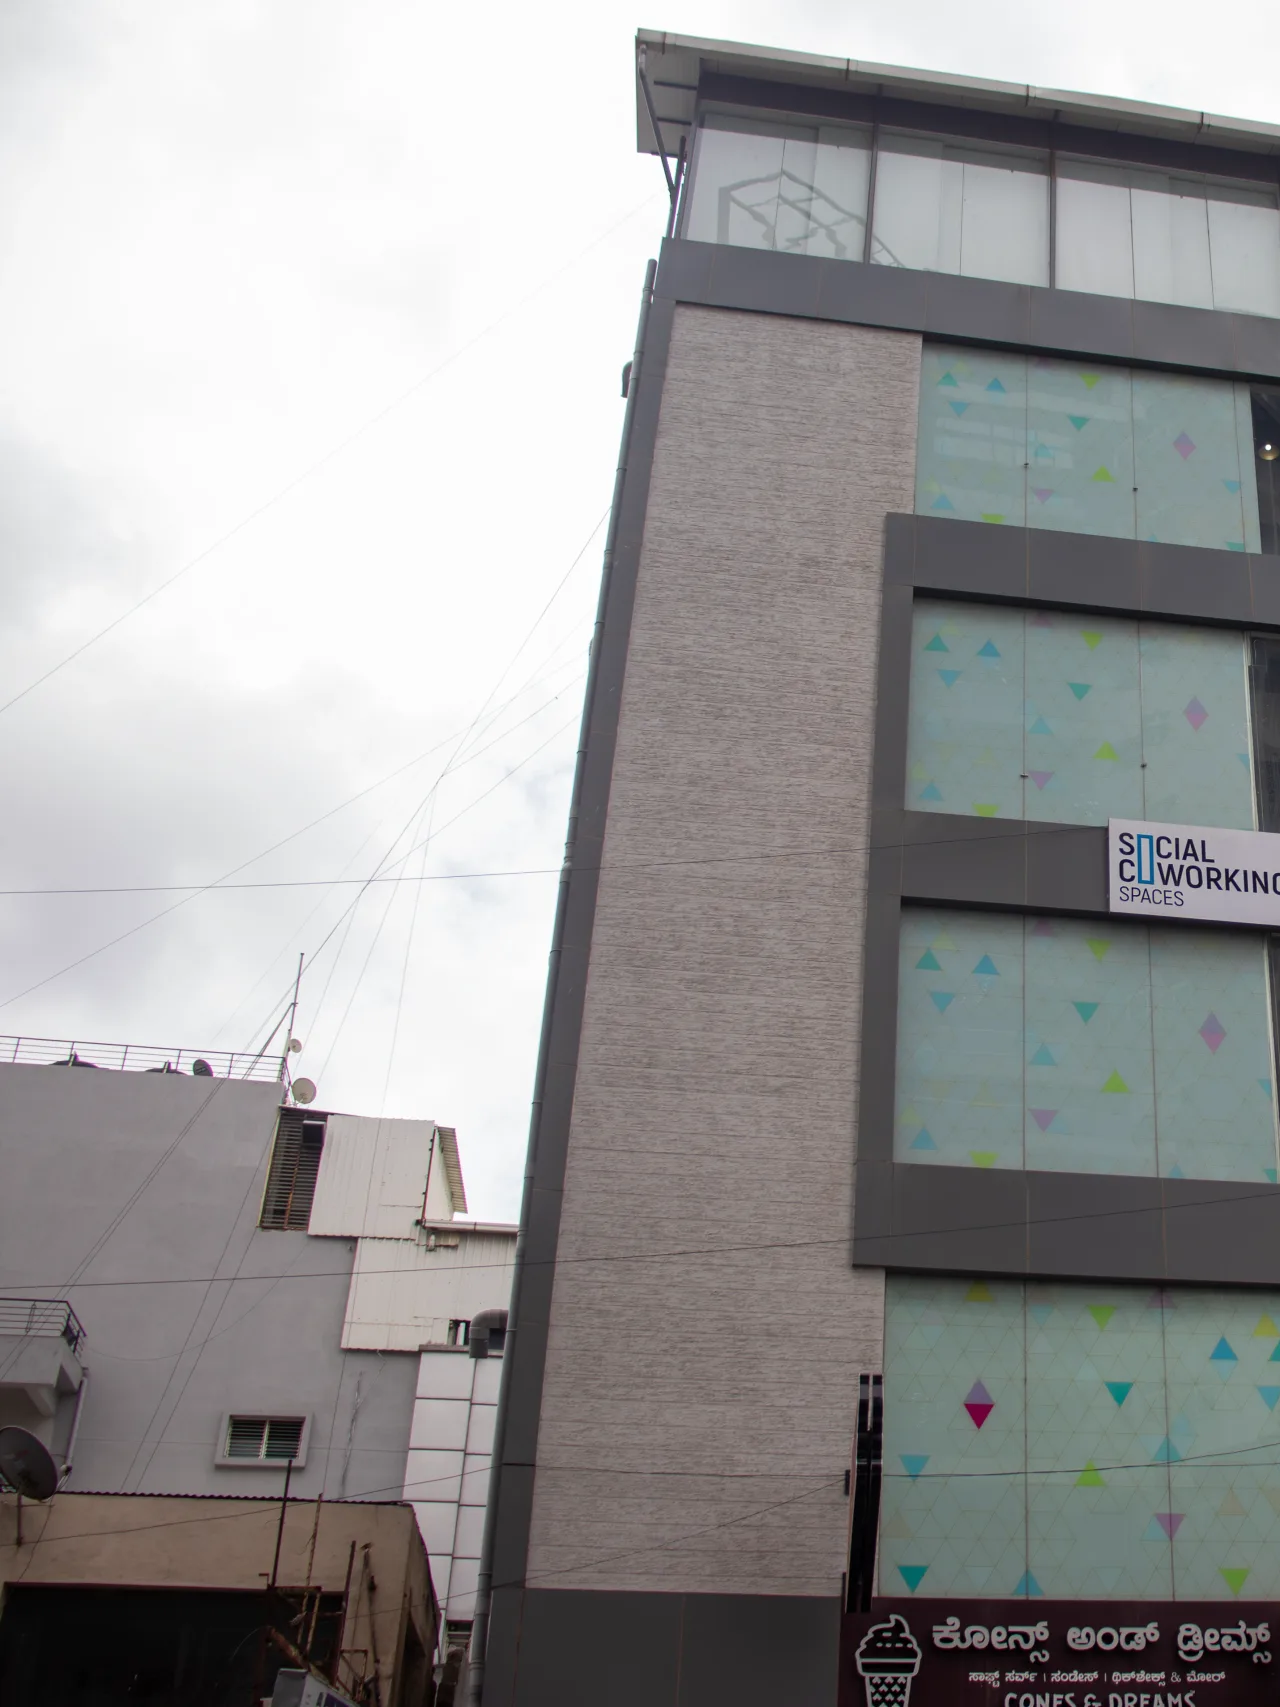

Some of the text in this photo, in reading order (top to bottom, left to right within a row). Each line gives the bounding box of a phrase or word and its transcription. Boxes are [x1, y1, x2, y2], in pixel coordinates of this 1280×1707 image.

[1118, 832, 1215, 864] SOCIAL
[1119, 886, 1184, 907] SPACES
[932, 1616, 1272, 1664] ಕೋನ್ಸ್ ಅಂಡ್ ಡ್ರೀಮ್ಸ್
[1186, 1670, 1226, 1683] ಮೋರ್
